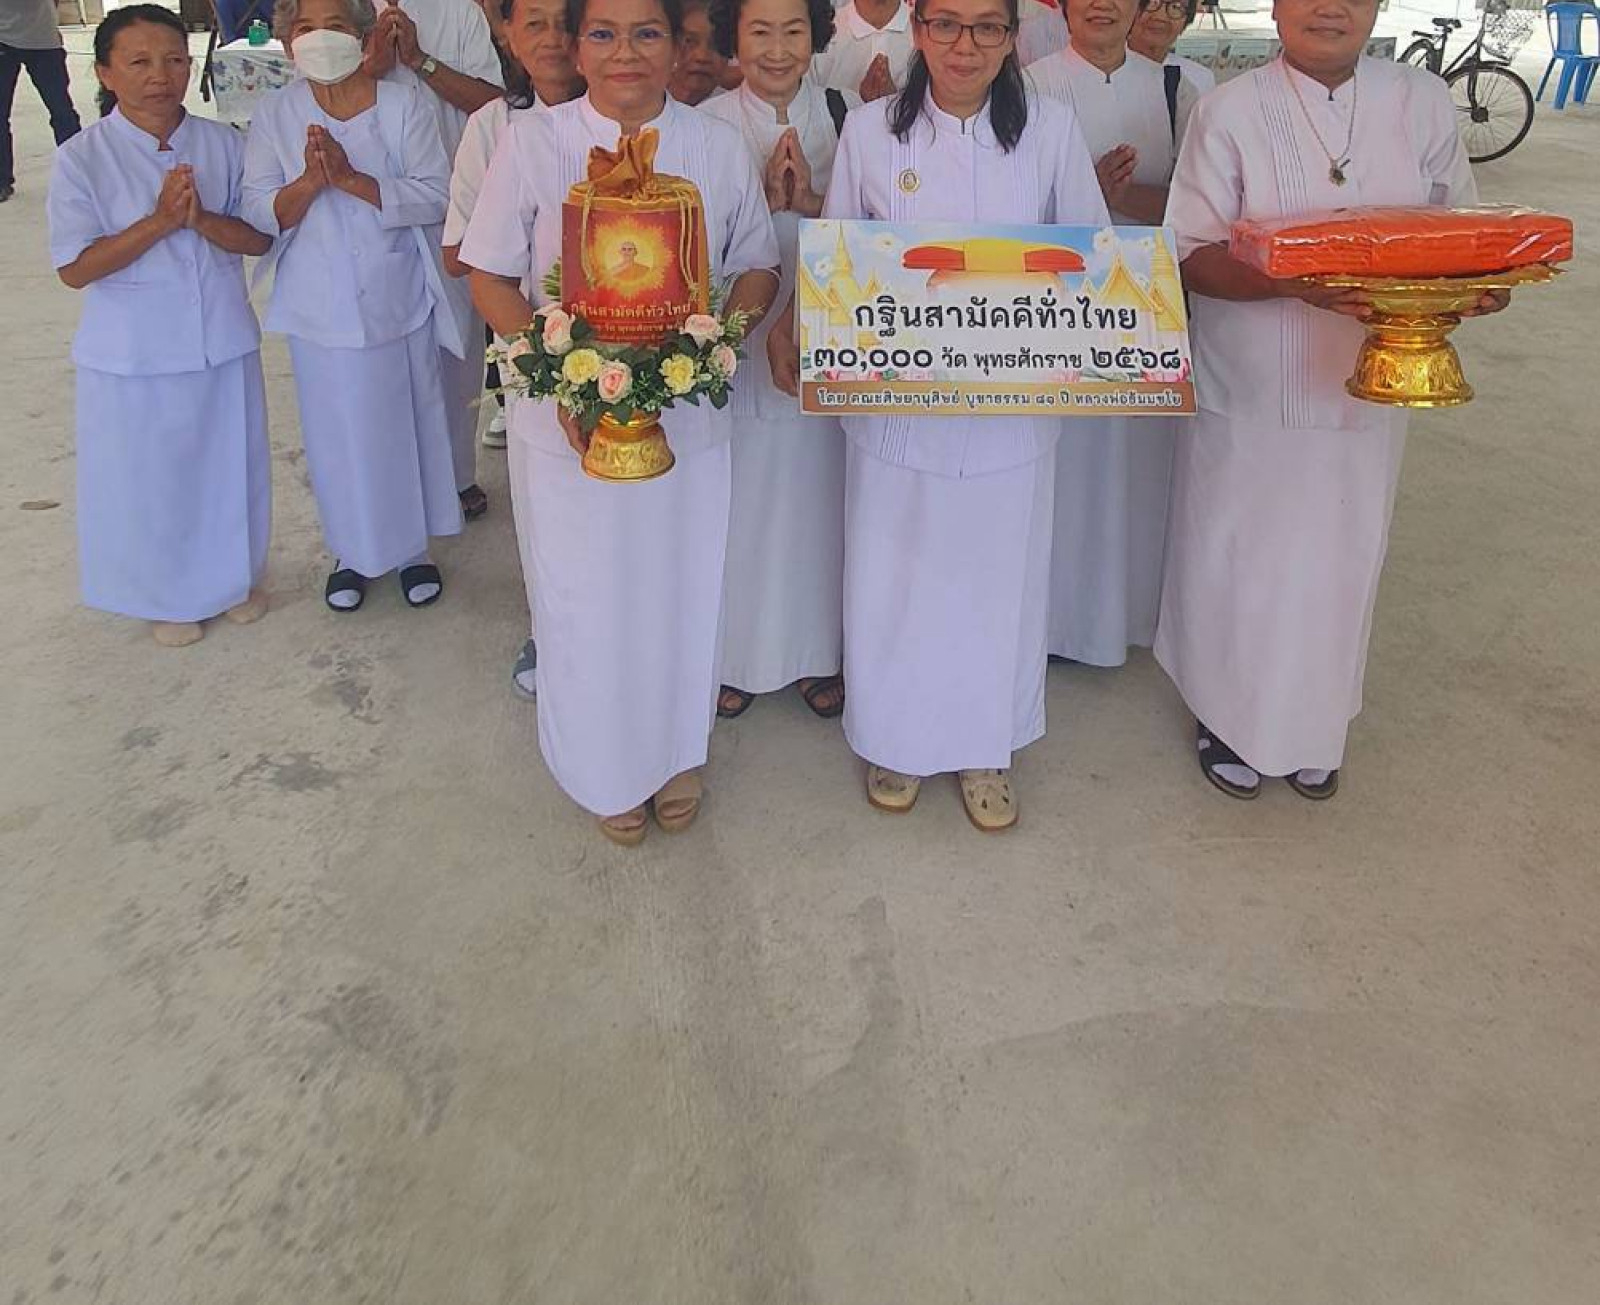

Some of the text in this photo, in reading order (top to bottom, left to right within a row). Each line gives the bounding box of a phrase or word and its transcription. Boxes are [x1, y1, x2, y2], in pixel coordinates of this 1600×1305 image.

[856, 287, 1137, 337] กฐินสามัคคีทั่วไทย
[814, 346, 1181, 376] ๓๐,๐๐๐ วัด พุทธศักราช ๒๕๖๘
[818, 388, 846, 405] โดย
[966, 392, 1030, 408] บูชาธรรม
[1060, 389, 1069, 405] ปี
